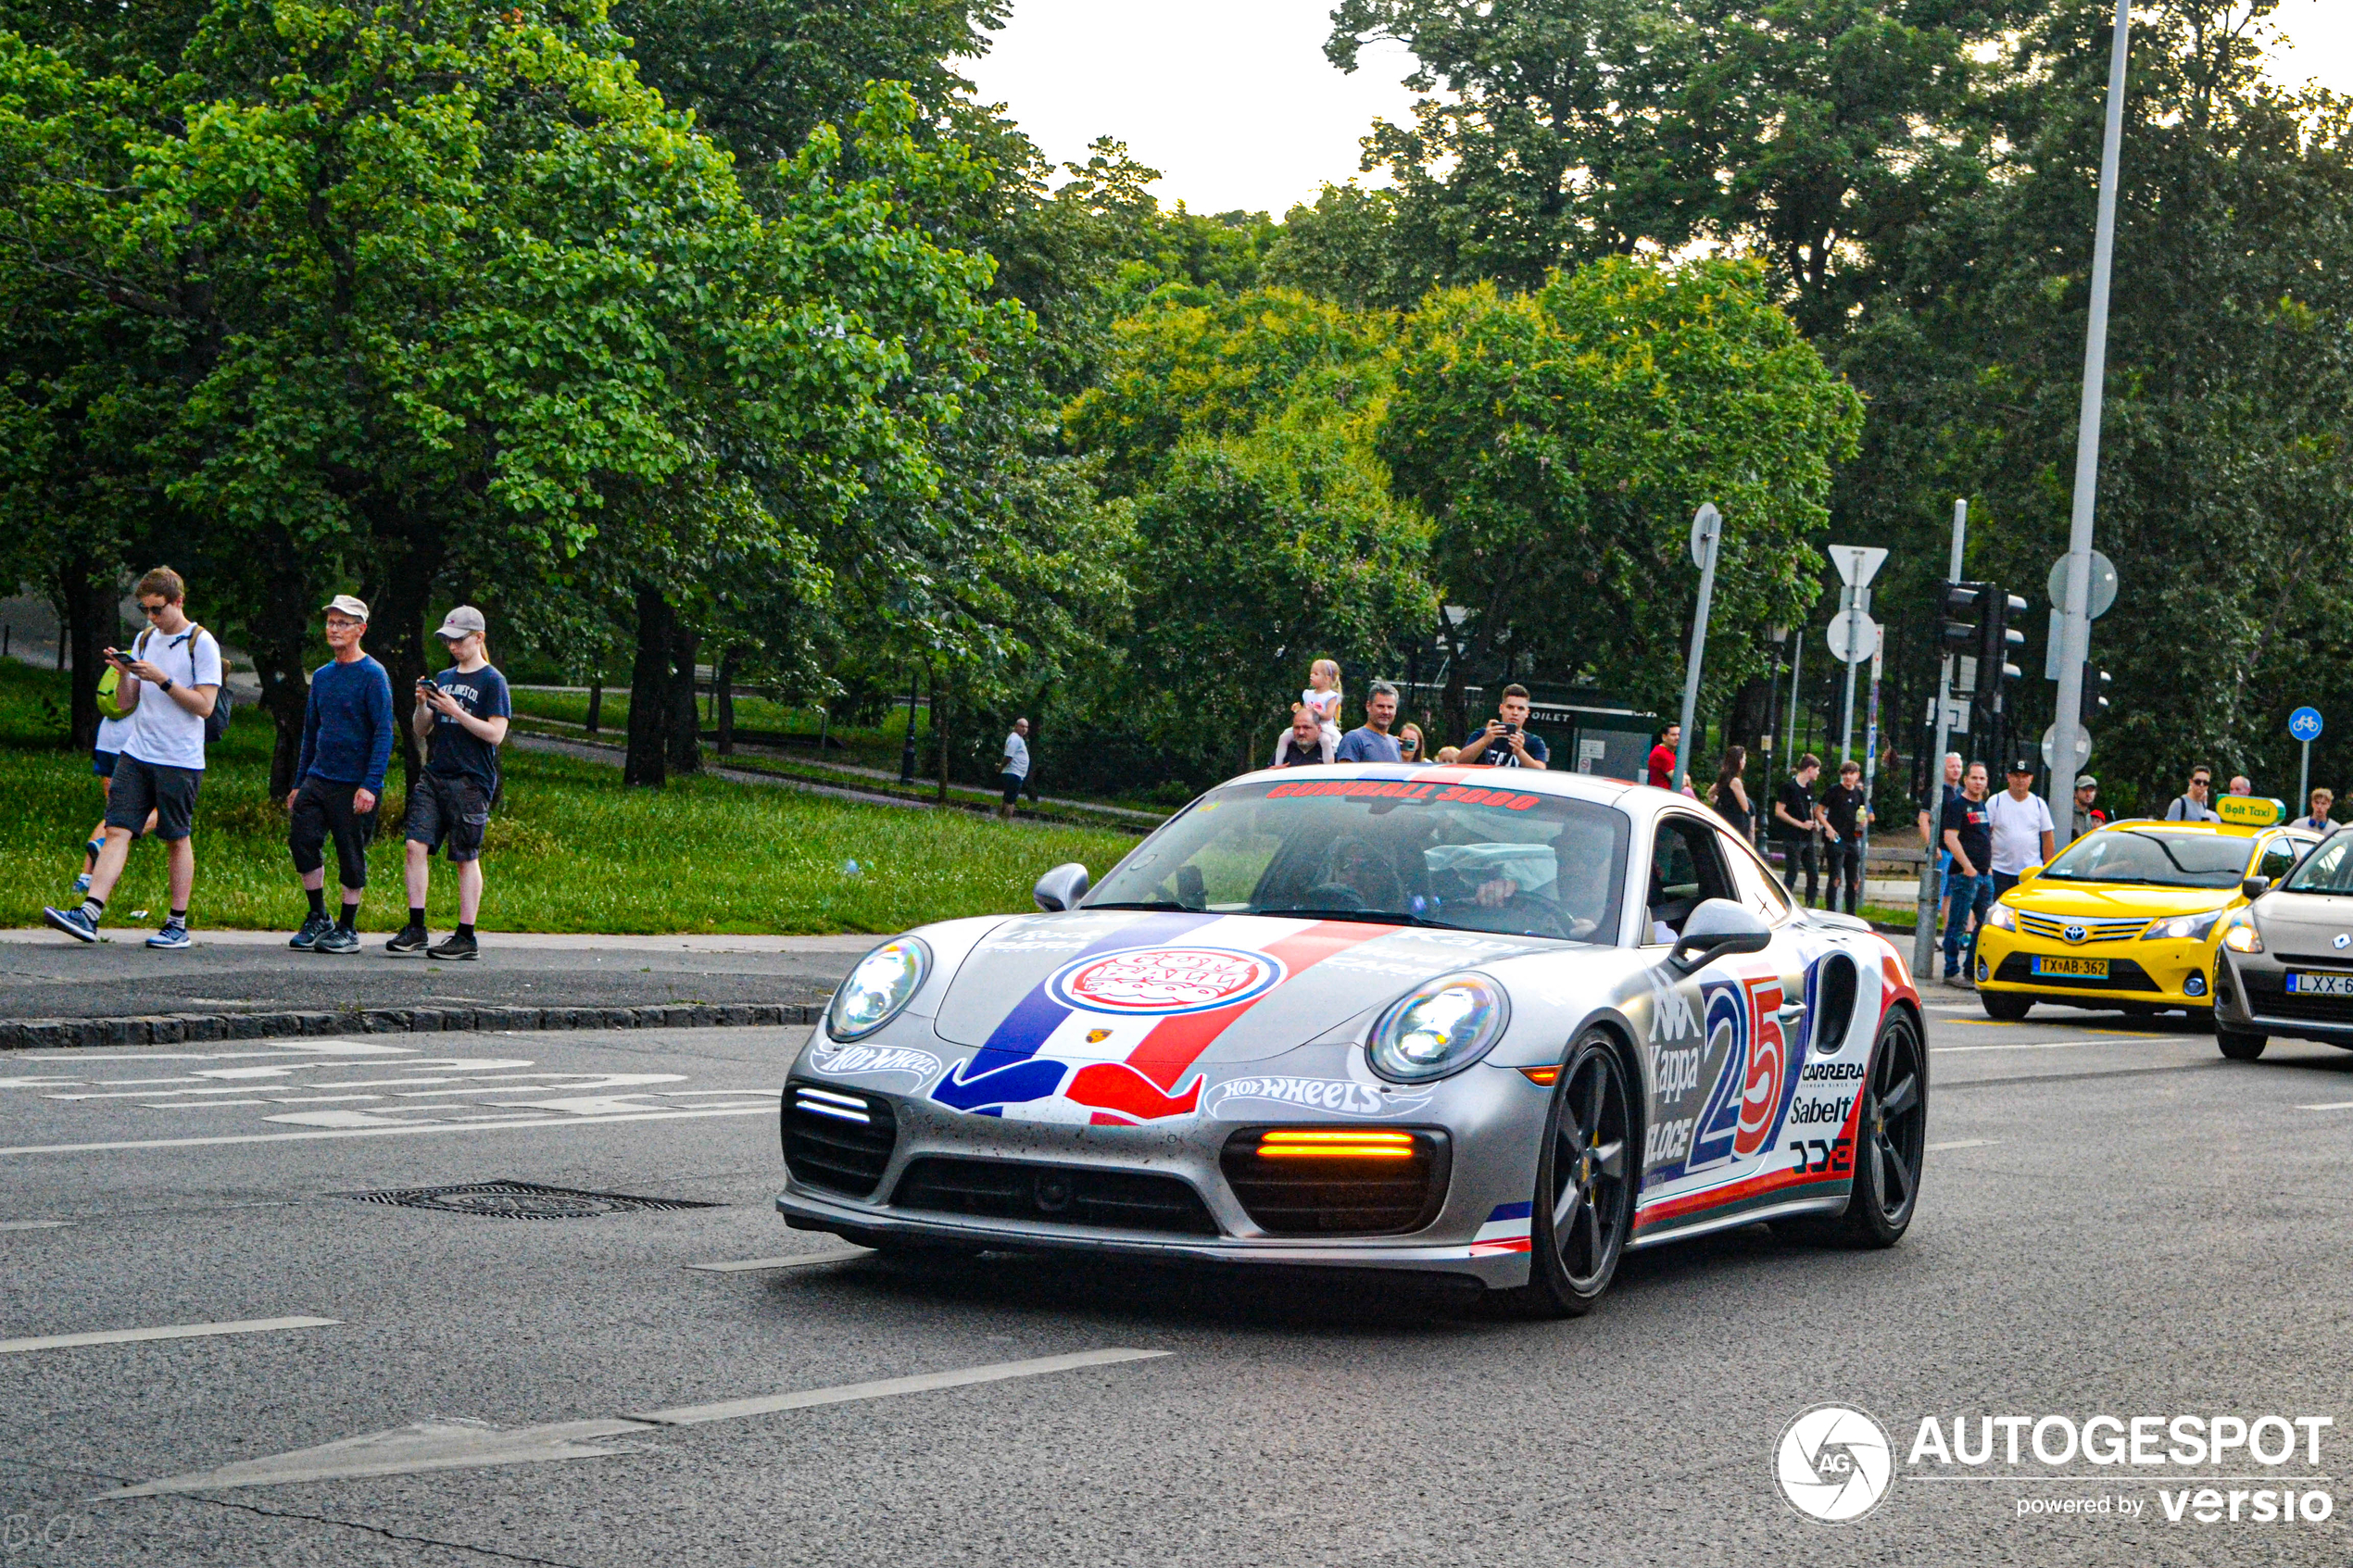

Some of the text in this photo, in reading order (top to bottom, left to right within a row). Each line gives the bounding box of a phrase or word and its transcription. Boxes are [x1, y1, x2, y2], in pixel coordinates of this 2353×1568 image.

[1529, 710, 1570, 722] OILET
[2017, 760, 2026, 771] S
[1265, 782, 1541, 812] GUMBALL 3000
[2224, 803, 2271, 817] Bolt Taxi
[1649, 1045, 1699, 1103] Kappa
[1684, 961, 1786, 1174] 25
[1802, 1062, 1865, 1081] CARRERA
[1791, 1097, 1851, 1124] Sabelt
